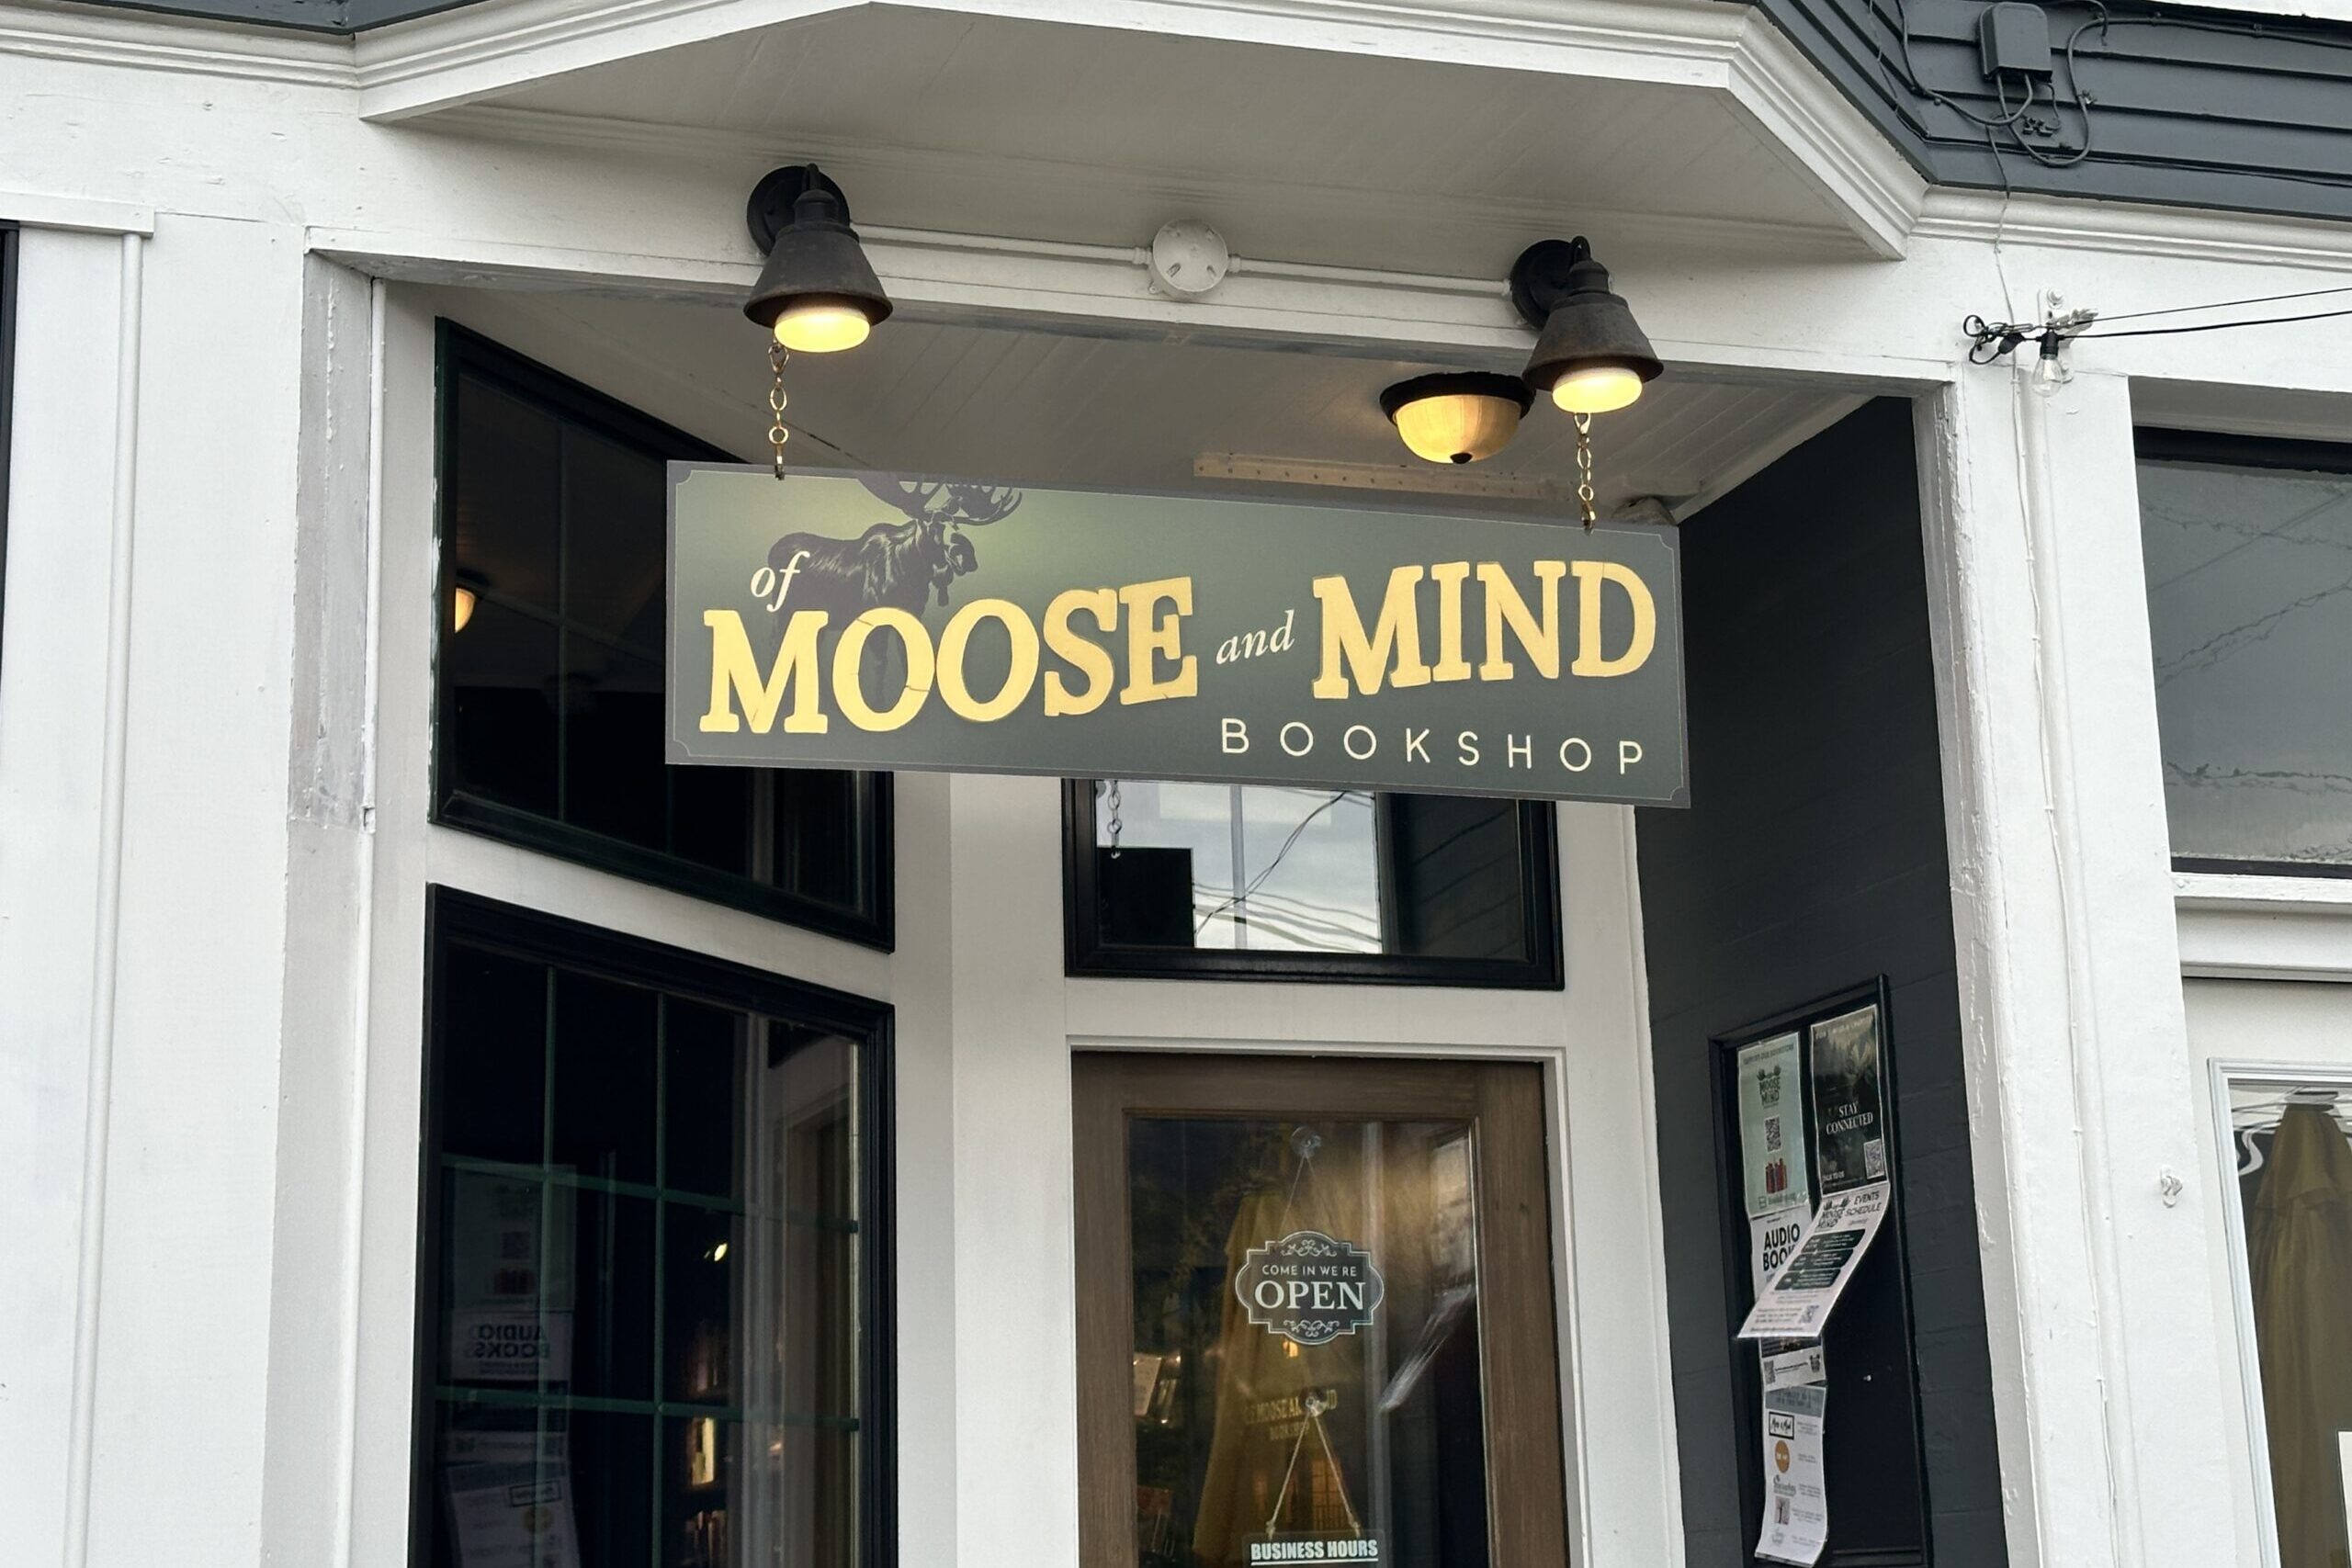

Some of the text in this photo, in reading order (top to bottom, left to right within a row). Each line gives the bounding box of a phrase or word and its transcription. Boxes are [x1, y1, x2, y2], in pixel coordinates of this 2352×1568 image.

[750, 551, 810, 613] of
[699, 560, 1657, 734] MOOSE and MIND
[1221, 717, 1643, 776] BOOKSHOP
[1838, 1100, 1858, 1118] STAY
[1826, 1111, 1873, 1135] CONNECTED
[1845, 1201, 1882, 1217] SCHEDULE
[1854, 1190, 1880, 1205] EVENTS
[1764, 1224, 1800, 1251] AUDIO
[1262, 1264, 1297, 1276] COME
[1303, 1265, 1316, 1276] IN
[1254, 1280, 1366, 1310] OPEN
[1250, 1539, 1378, 1562] BUSINESS HOURS
